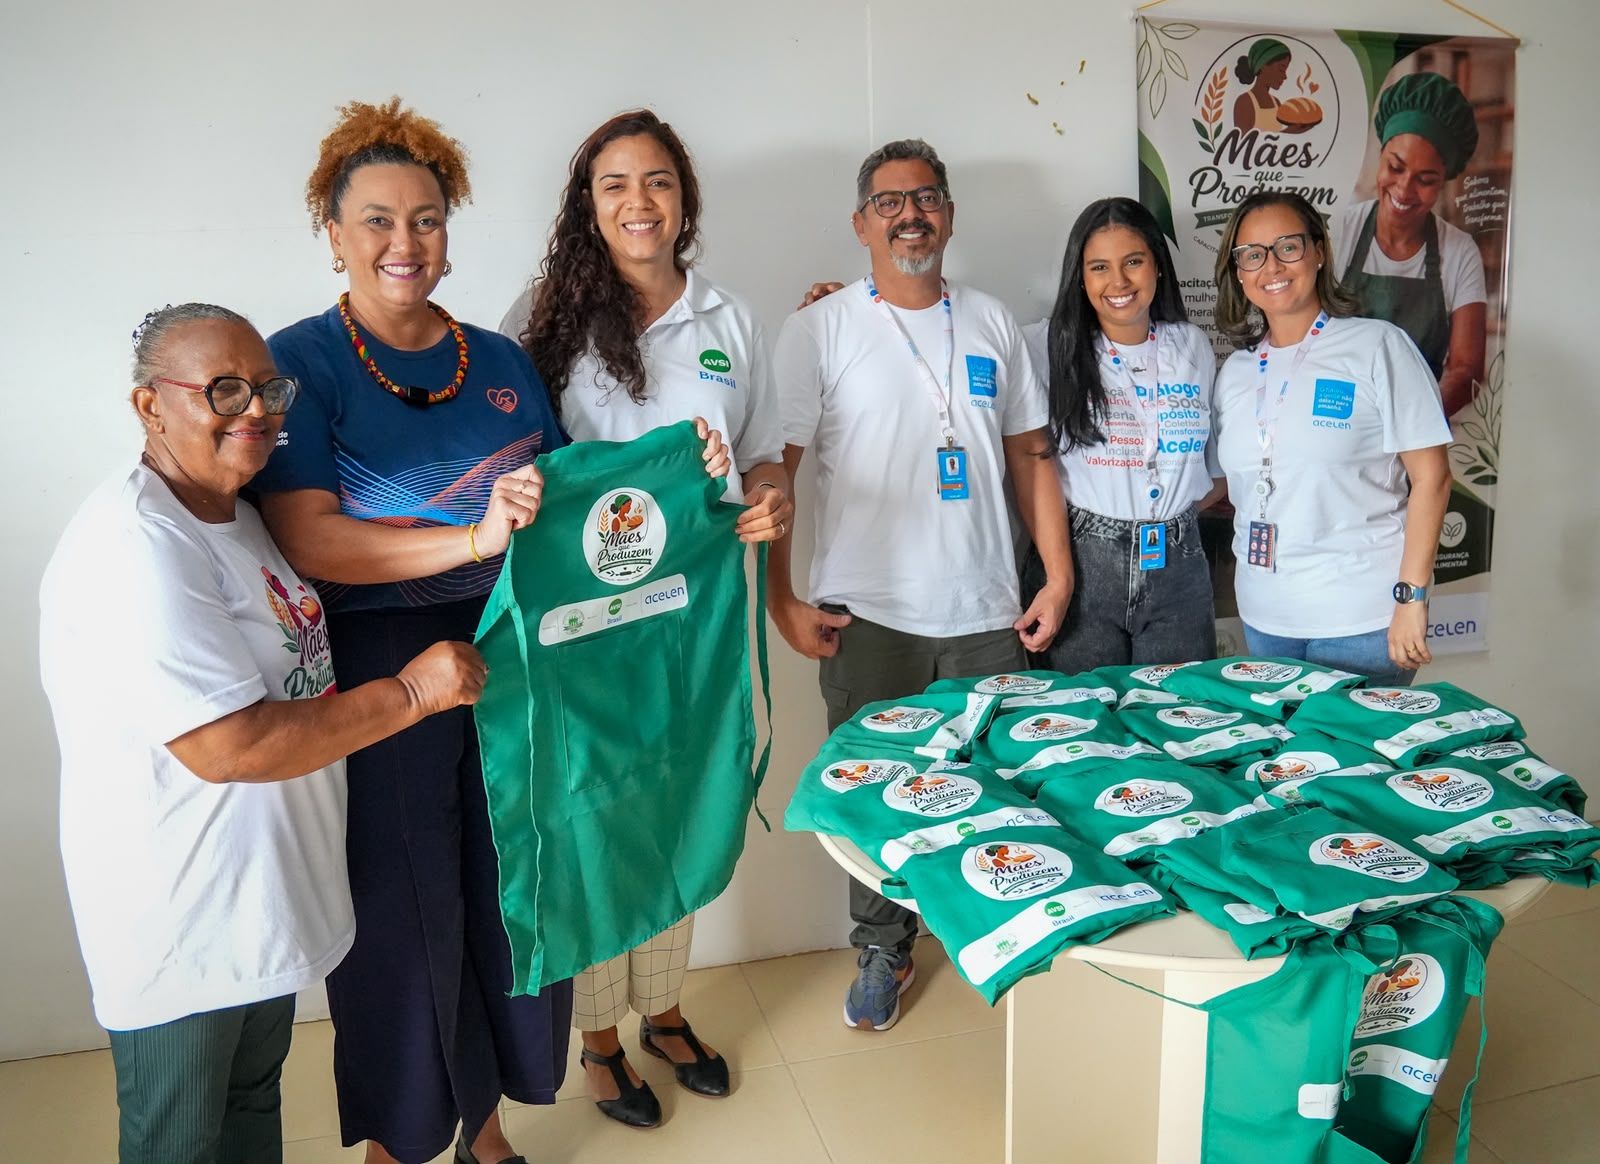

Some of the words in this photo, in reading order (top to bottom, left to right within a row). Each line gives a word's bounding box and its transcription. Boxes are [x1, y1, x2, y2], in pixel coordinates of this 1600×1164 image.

[1213, 129, 1319, 170] Mães
[1255, 171, 1284, 186] que
[704, 358, 729, 368] AVSI
[700, 371, 736, 389] Brasil
[1086, 456, 1144, 467] Valorização
[605, 531, 644, 548] Mães
[598, 548, 653, 566] Produzem
[644, 586, 685, 604] acelen
[910, 787, 973, 808] Produzem
[990, 866, 1061, 891] Produzem
[1100, 888, 1154, 901] acelen
[1052, 914, 1075, 927] Brasil
